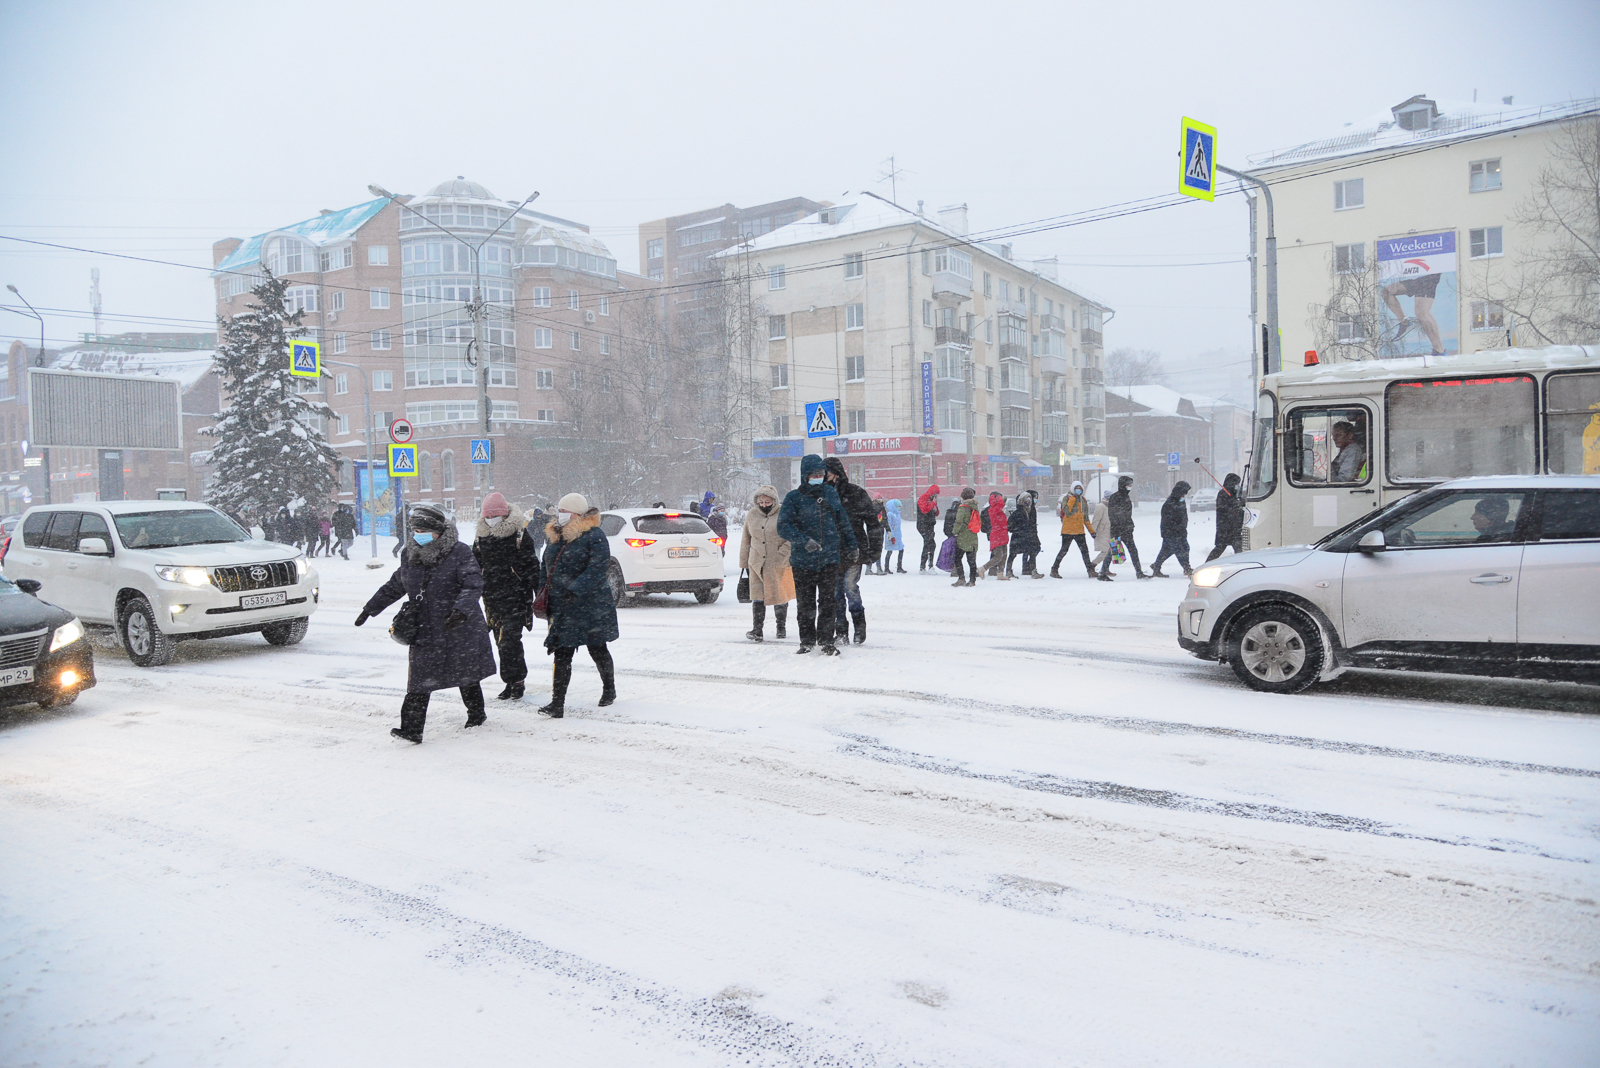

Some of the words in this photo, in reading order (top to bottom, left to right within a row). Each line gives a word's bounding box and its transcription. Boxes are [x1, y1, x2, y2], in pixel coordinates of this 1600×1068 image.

[1389, 236, 1443, 253] Weekend
[923, 364, 931, 427] ОРТОПЕДИЯ
[852, 439, 877, 451] ПОЧТА
[244, 596, 275, 606] О535АХ
[16, 669, 29, 679] 29
